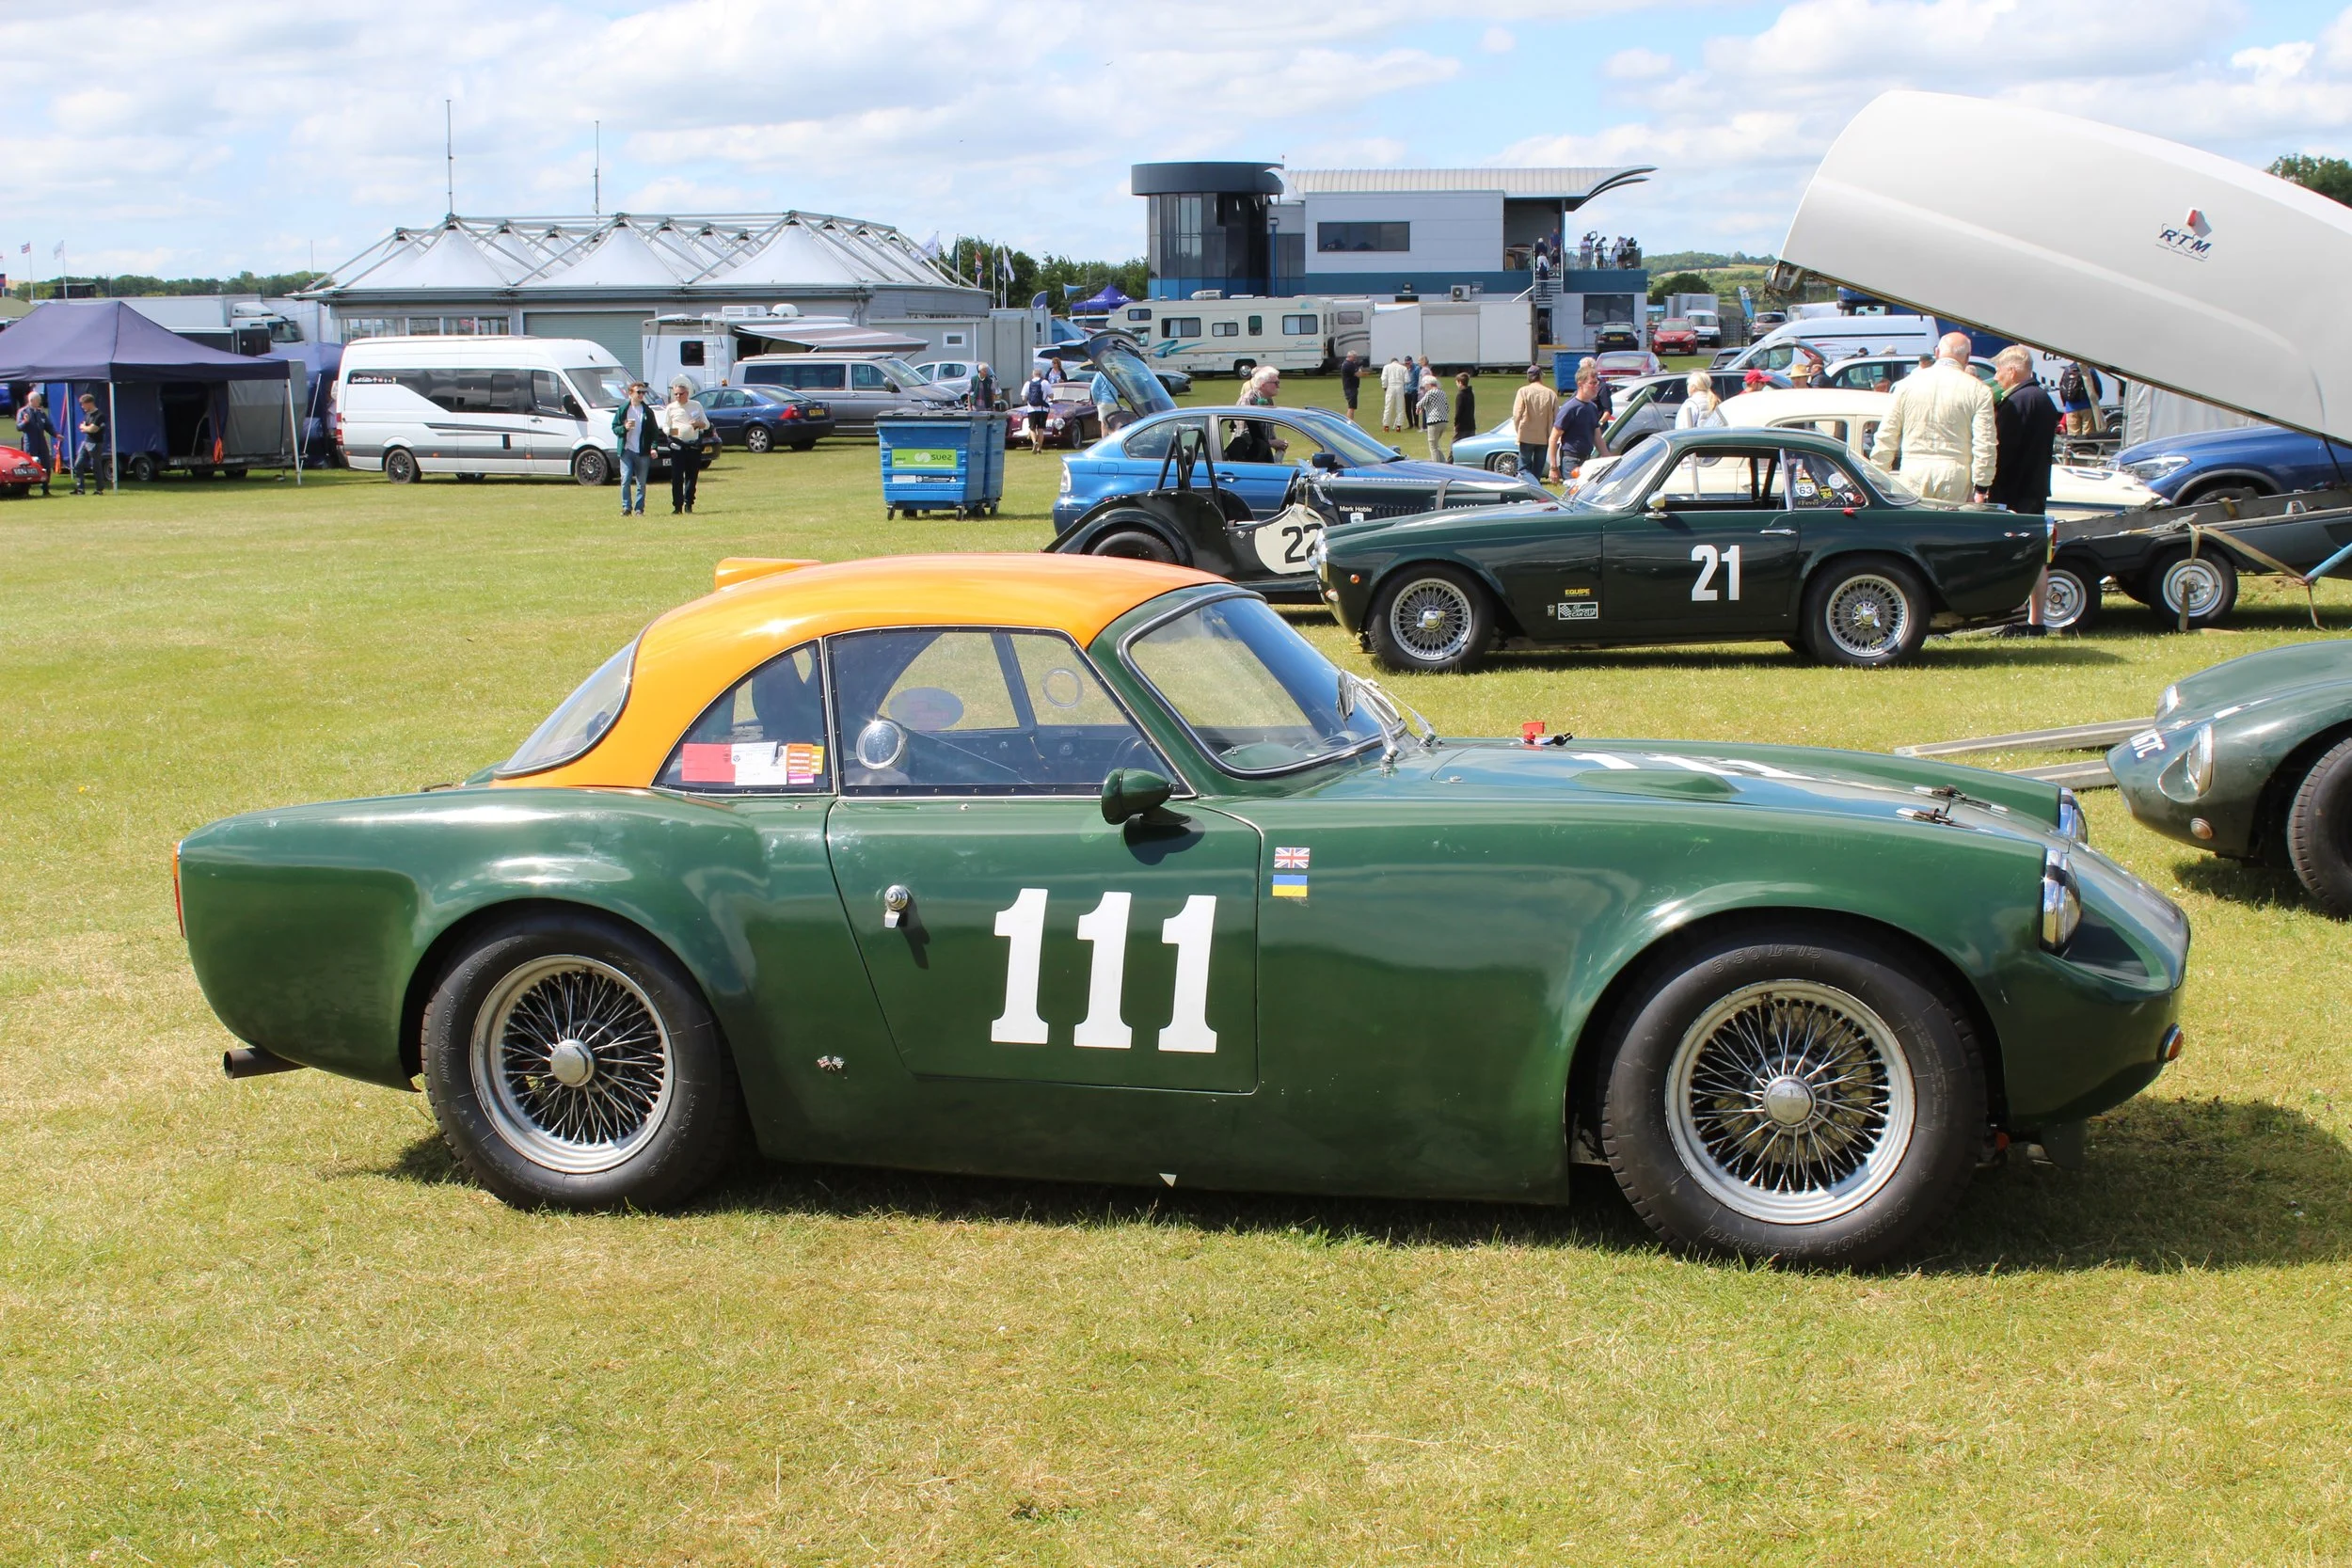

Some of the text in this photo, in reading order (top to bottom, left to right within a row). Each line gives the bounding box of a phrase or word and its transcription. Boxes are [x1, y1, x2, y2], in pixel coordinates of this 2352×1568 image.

[2159, 229, 2212, 253] RTM
[1799, 486, 1813, 495] 63
[1691, 545, 1740, 601] 21
[991, 888, 1217, 1053] 111
